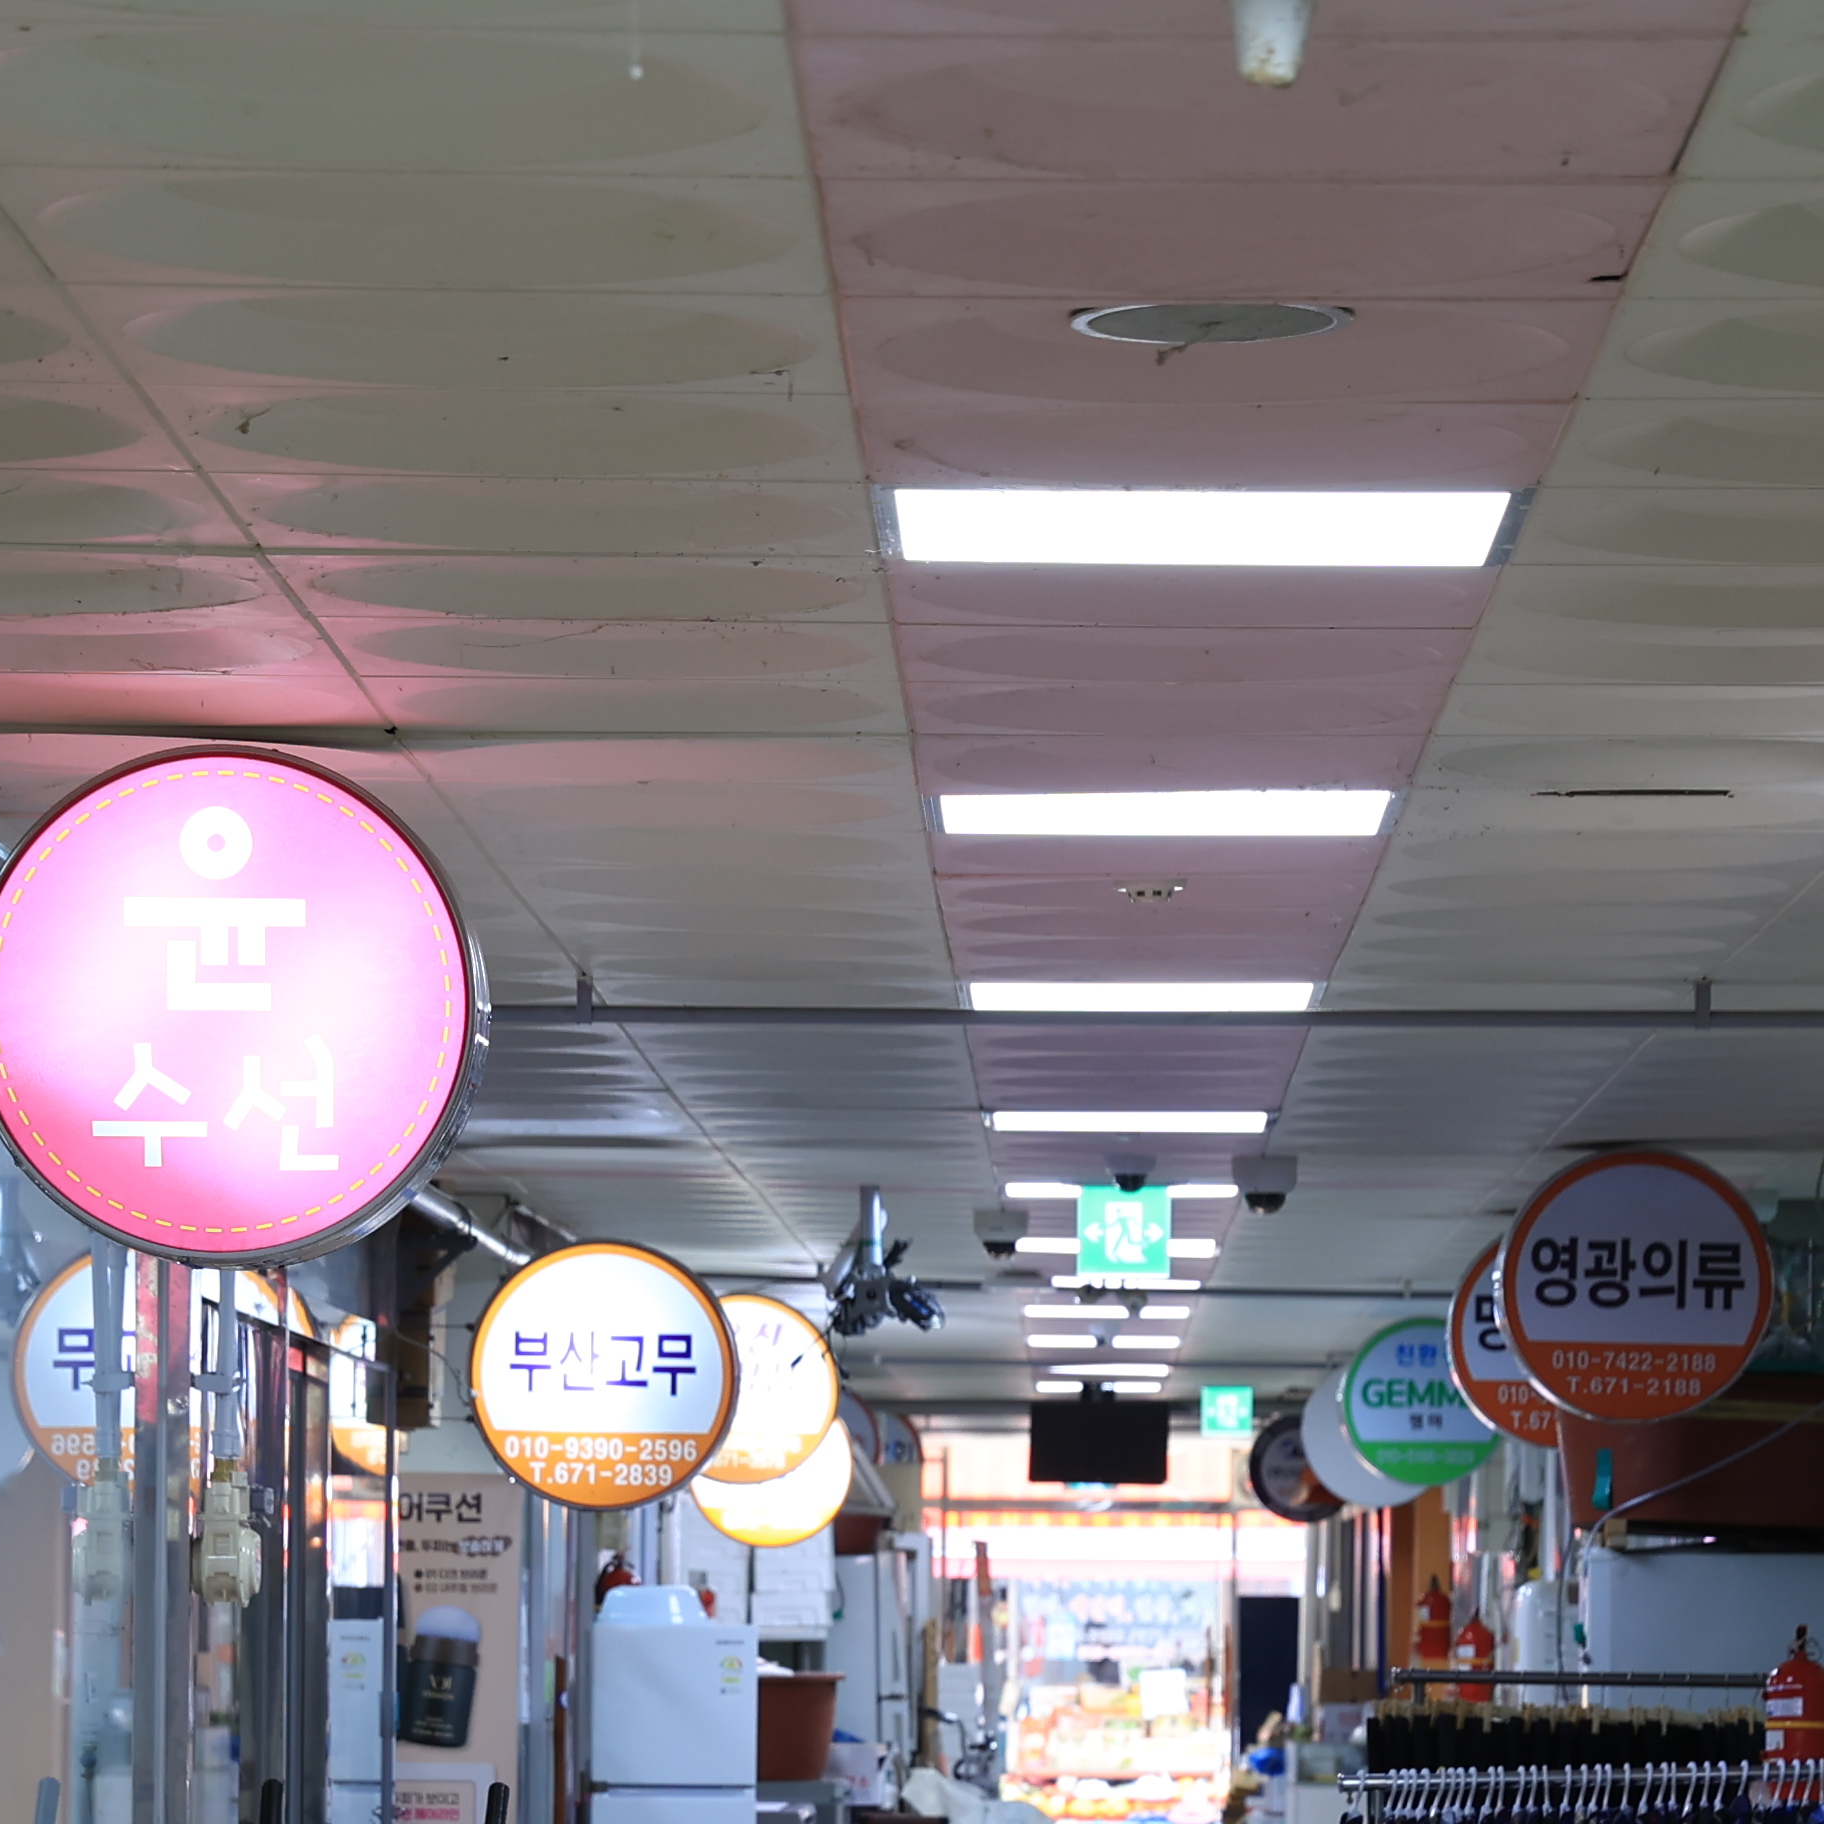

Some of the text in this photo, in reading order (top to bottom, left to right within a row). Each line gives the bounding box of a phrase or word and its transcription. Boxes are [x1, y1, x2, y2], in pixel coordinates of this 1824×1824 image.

[123, 806, 306, 1011] 윤
[92, 1033, 340, 1171] 수선
[1531, 1236, 1745, 1310] 영광의류
[509, 1331, 697, 1397] 부산고무
[1552, 1351, 1717, 1372] 010-7422-2188
[1567, 1376, 1702, 1396] T.671-2188
[505, 1435, 697, 1462] 010-9390-2596
[529, 1461, 673, 1486] T.671-2839
